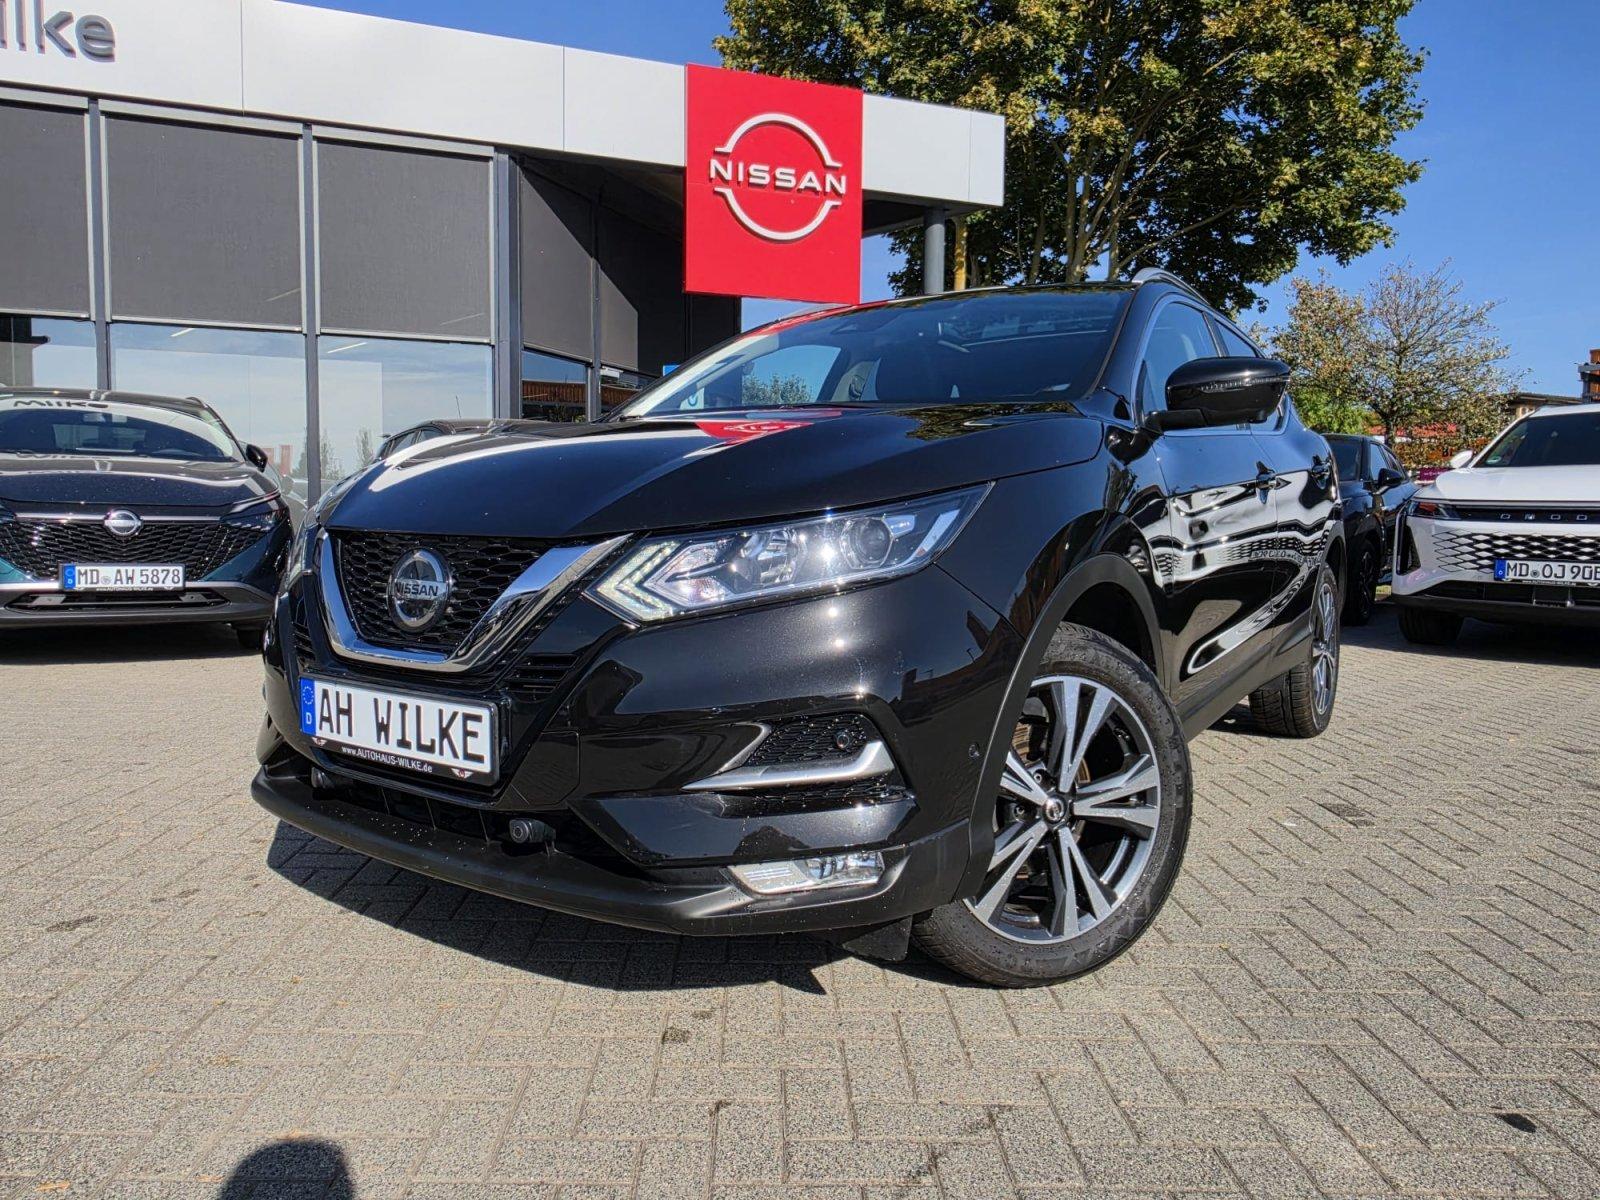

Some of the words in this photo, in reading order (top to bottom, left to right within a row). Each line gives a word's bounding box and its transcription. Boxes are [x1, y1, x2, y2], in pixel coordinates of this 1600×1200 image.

[709, 158, 847, 196] NISSAN
[77, 569, 100, 585] MD
[113, 569, 135, 585] AW
[139, 569, 181, 585] 5878
[1506, 562, 1530, 578] MD
[1541, 563, 1566, 579] OJ
[304, 711, 313, 725] D
[318, 688, 354, 738] AH
[373, 697, 486, 764] WILKE
[341, 746, 434, 774] www.AUTOHAUS-WILKE.de
